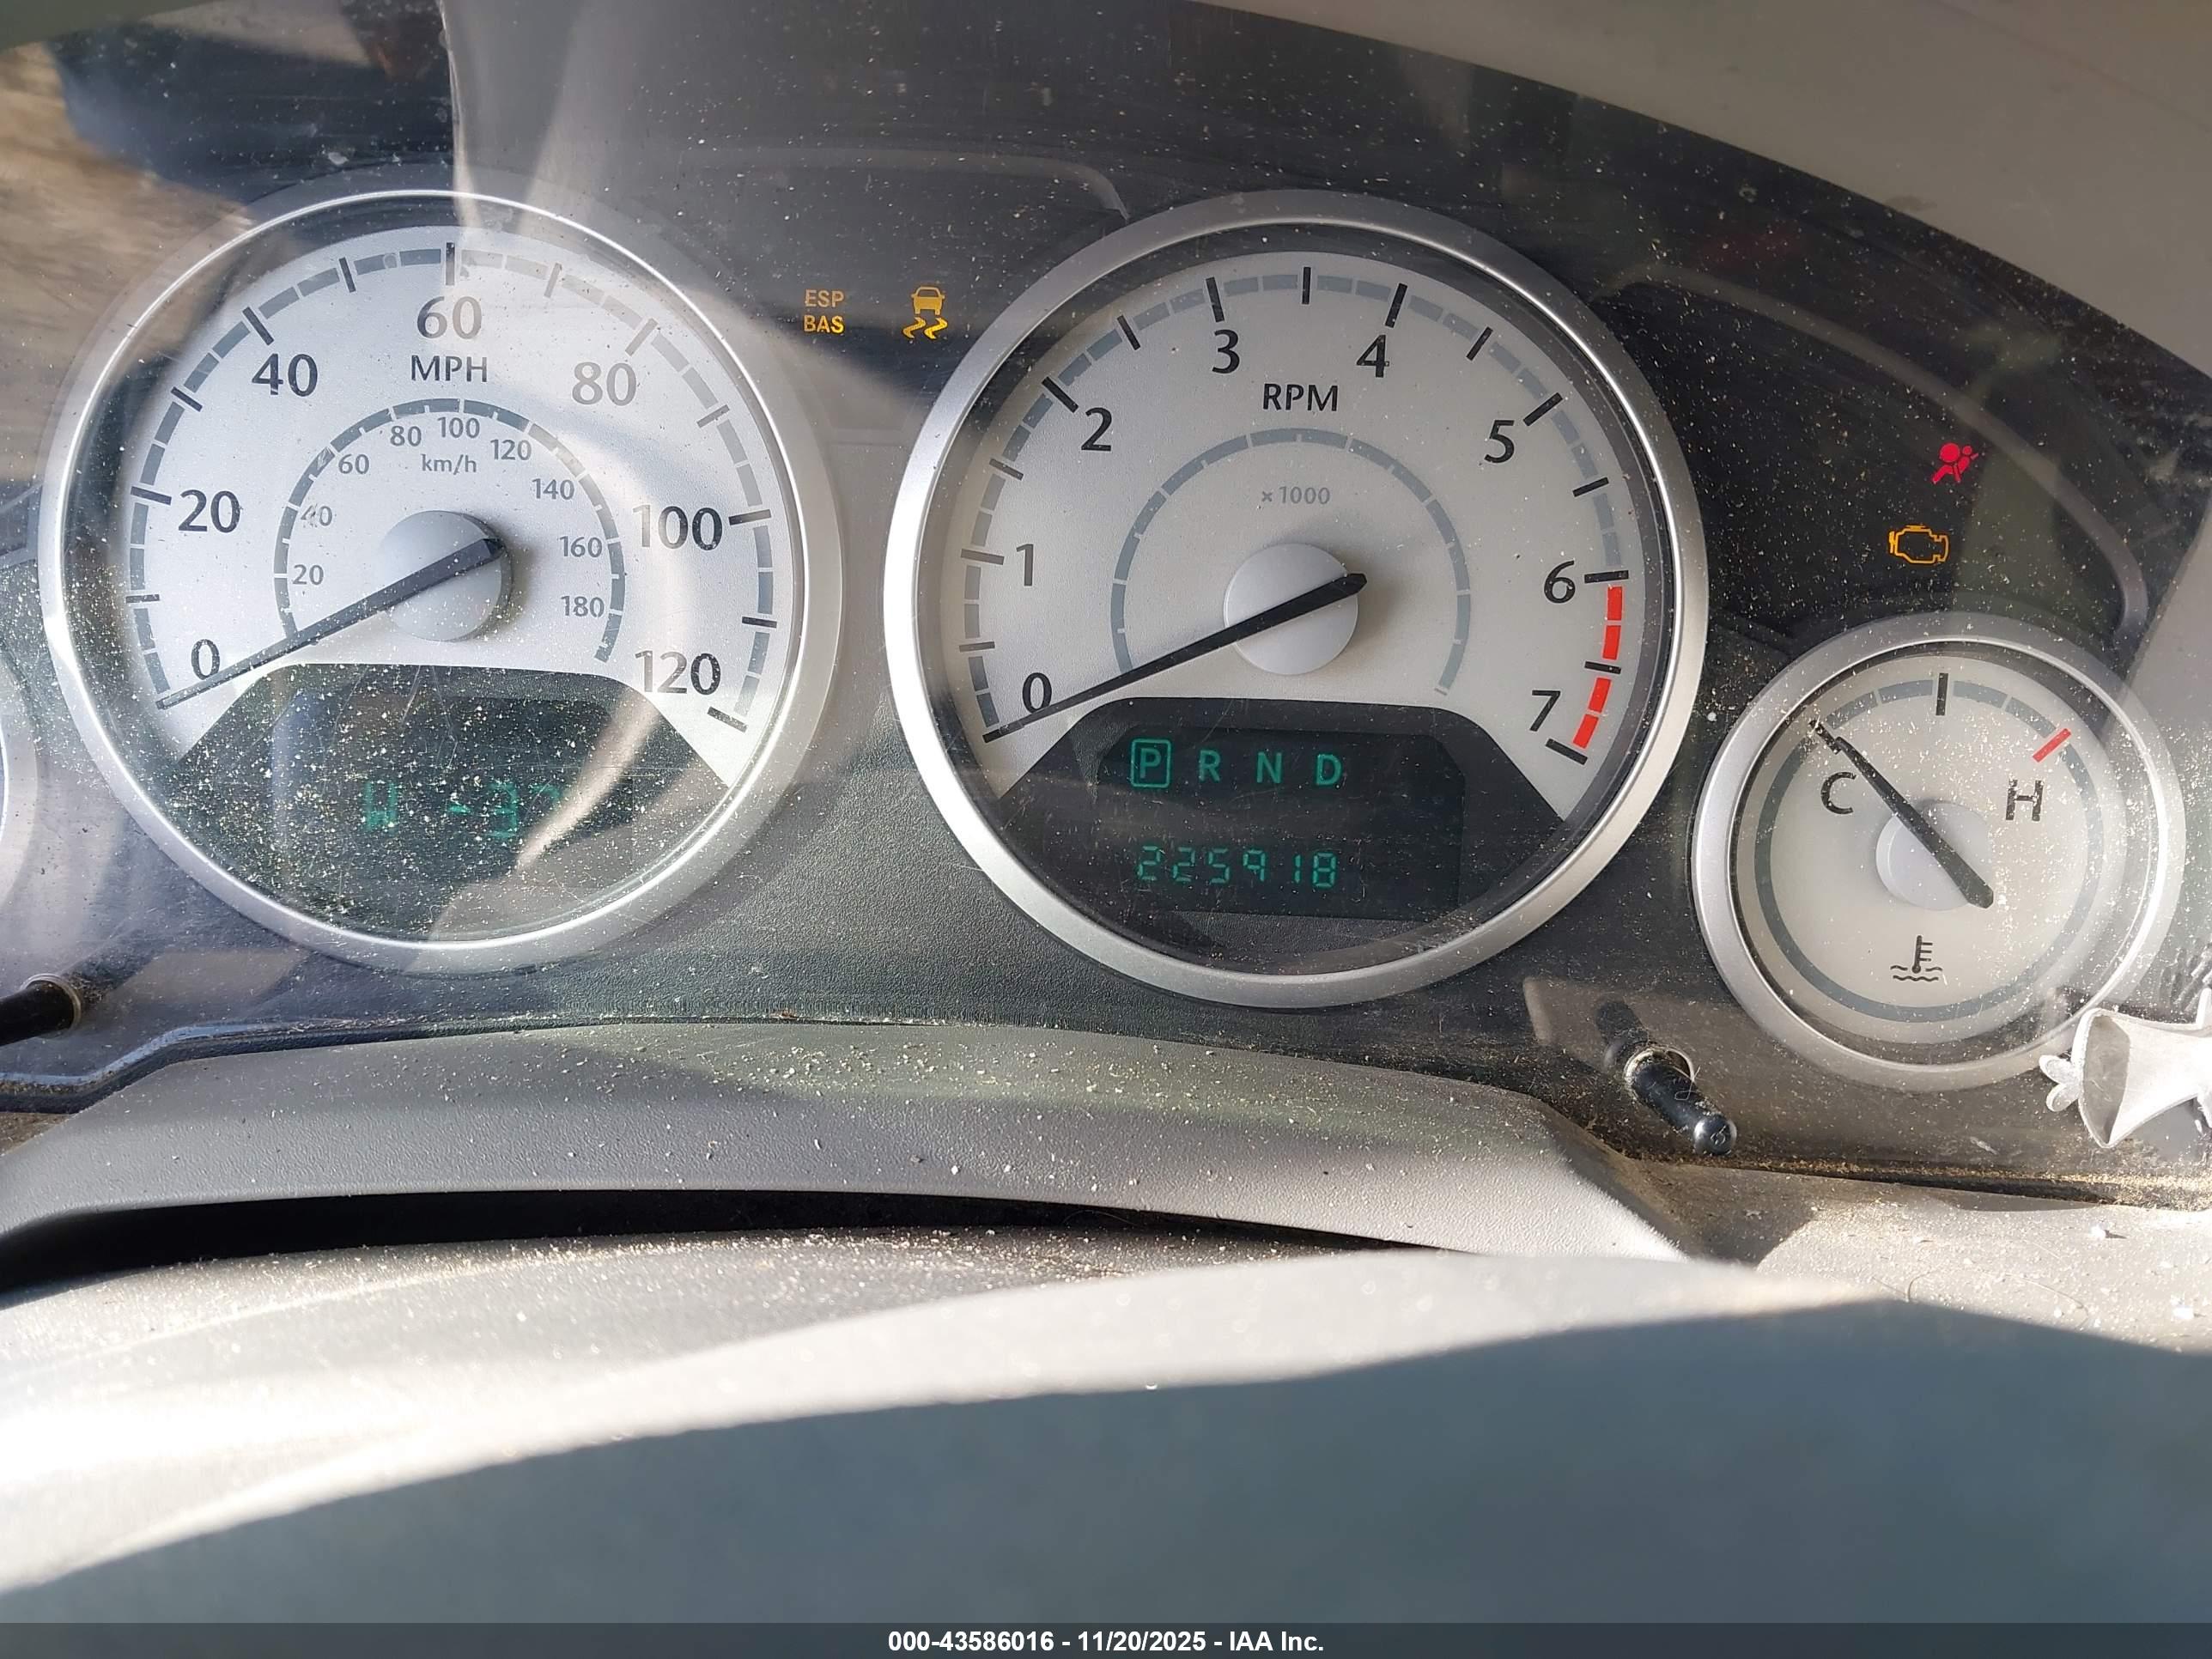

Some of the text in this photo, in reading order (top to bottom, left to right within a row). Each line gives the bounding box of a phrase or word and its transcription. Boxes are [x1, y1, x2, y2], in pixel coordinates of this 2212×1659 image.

[416, 295, 483, 339] 60
[804, 289, 845, 307] ESP
[803, 315, 845, 334] BAS
[410, 355, 489, 383] MPH
[1212, 329, 1240, 374] 3
[1356, 334, 1389, 378] 4
[252, 354, 319, 397] 40
[571, 362, 637, 406] 80
[1262, 383, 1339, 412] RPM
[389, 424, 422, 447] 80
[438, 416, 480, 440] 100
[1080, 407, 1113, 452] 2
[1484, 420, 1516, 464] 5
[337, 453, 370, 476] 60
[421, 453, 477, 475] km/h
[490, 439, 532, 462] 120
[532, 478, 574, 501] 140
[178, 489, 241, 533] 20
[301, 504, 333, 527] 40
[633, 504, 723, 550] 100
[560, 536, 602, 559] 160
[1016, 543, 1034, 587] 1
[292, 563, 324, 586] 20
[1542, 560, 1576, 605] 6
[560, 594, 605, 617] 180
[191, 639, 220, 679] 0
[635, 650, 721, 696] 120
[1022, 672, 1053, 713] 0
[1530, 689, 1561, 731] 7
[1139, 748, 1342, 785] P R N D
[1820, 771, 1856, 815] C
[2005, 778, 2045, 822] H
[1137, 845, 1337, 888] 225918
